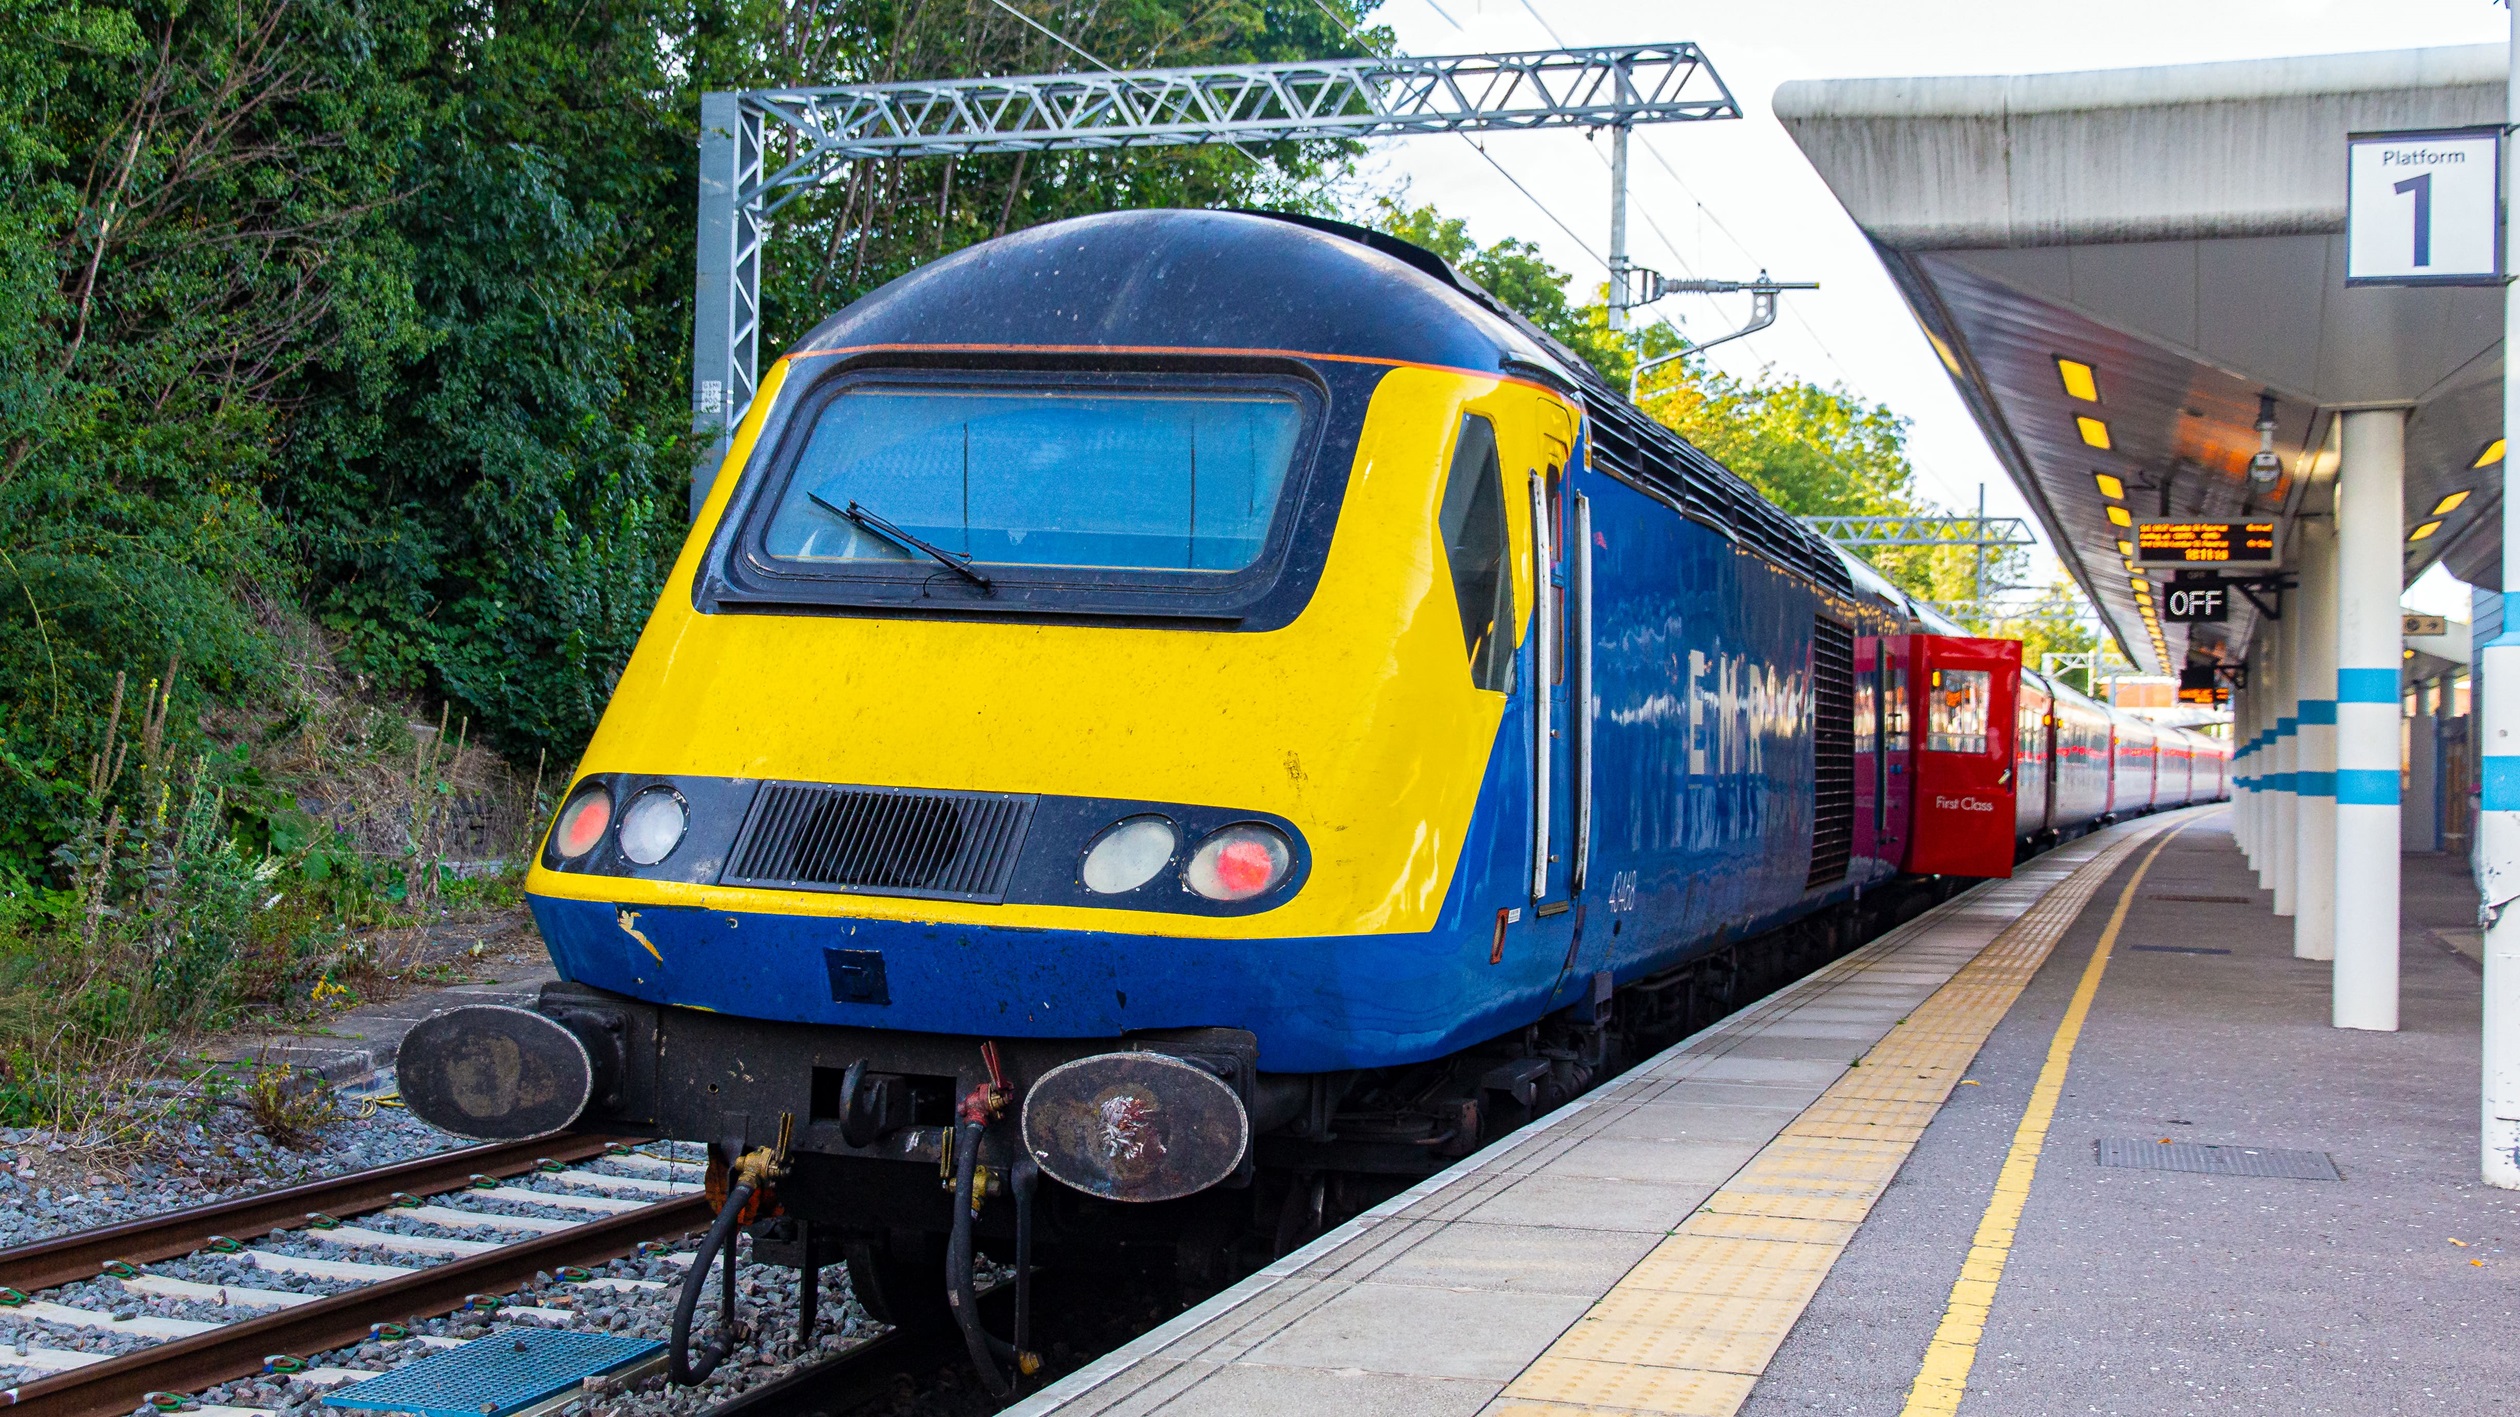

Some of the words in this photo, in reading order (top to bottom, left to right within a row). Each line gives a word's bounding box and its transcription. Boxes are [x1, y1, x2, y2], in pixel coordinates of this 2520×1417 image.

[2382, 148, 2466, 167] Platform
[2393, 172, 2433, 268] 1
[2169, 590, 2223, 616] OFF
[1689, 649, 1763, 775] EMR
[1936, 795, 1960, 809] First
[1961, 796, 1994, 812] Class
